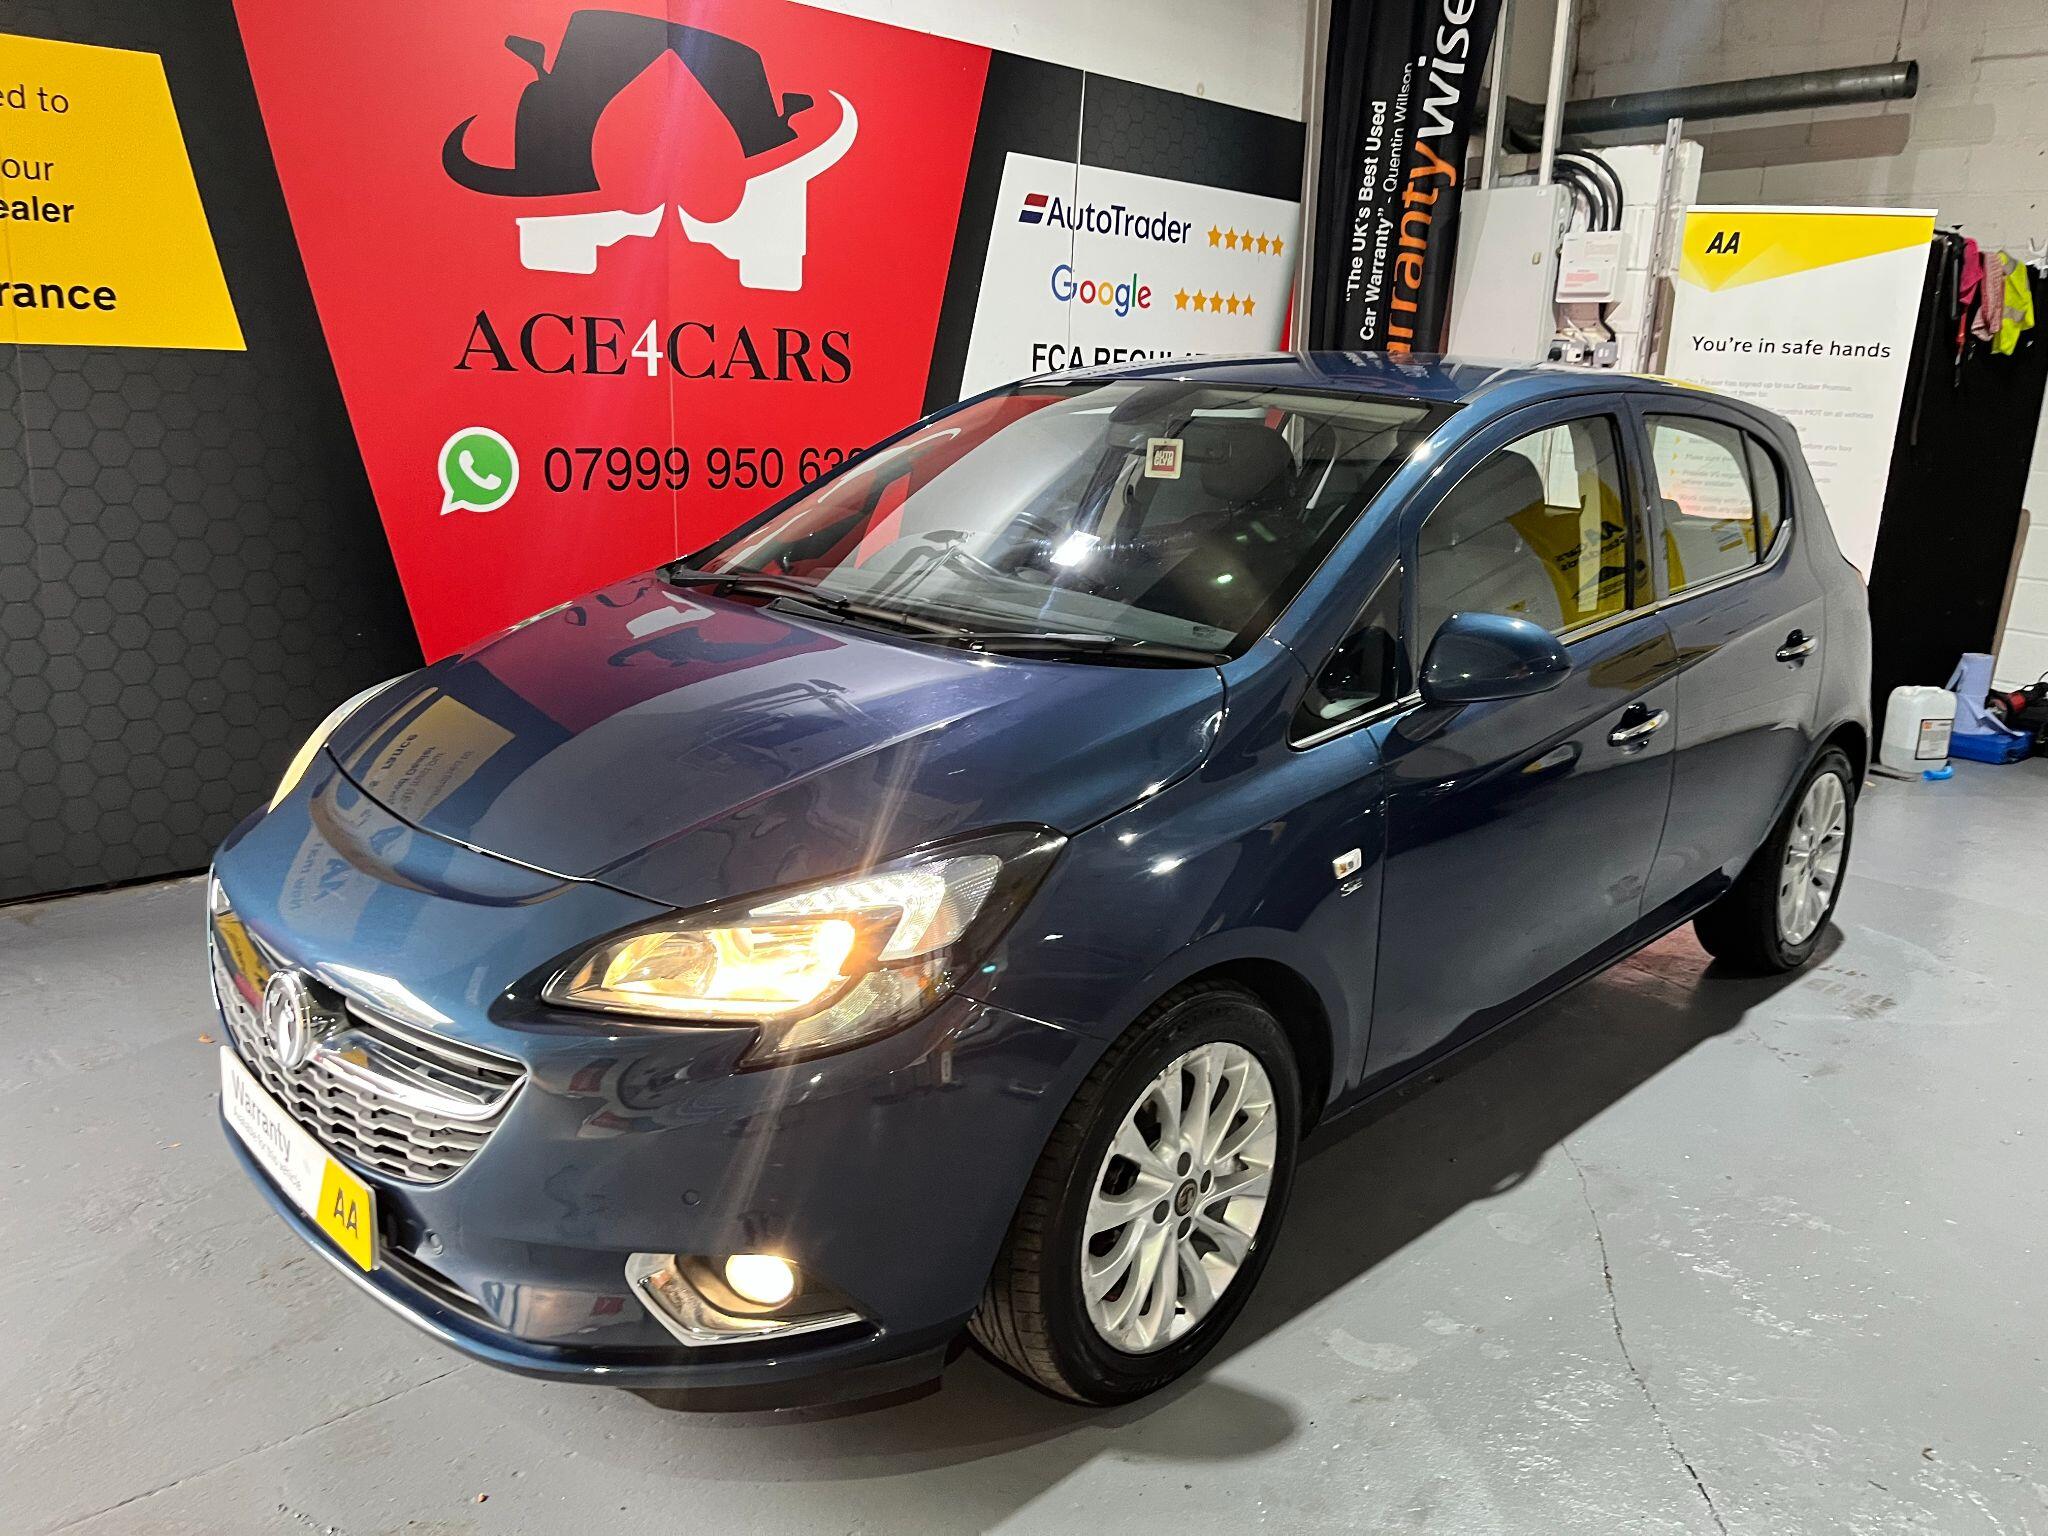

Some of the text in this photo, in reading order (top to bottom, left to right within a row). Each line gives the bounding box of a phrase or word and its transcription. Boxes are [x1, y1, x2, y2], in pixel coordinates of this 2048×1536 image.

[0, 83, 69, 113] d to
[1365, 101, 1387, 151] Used
[1358, 157, 1379, 201] Best
[1360, 307, 1377, 341] Car
[1383, 127, 1405, 192] Quentin
[1394, 62, 1413, 123] Willson
[1047, 196, 1191, 244] AutoTrader
[1705, 231, 1740, 254] AA
[1051, 264, 1152, 317] Google
[454, 309, 852, 384] ACE4CARS
[1032, 343, 1083, 373] FCA
[1758, 338, 1775, 353] in
[1782, 339, 1823, 356] safe
[1829, 341, 1891, 358] hands
[544, 447, 865, 492] 07999 950 63
[333, 1188, 359, 1239] AA
